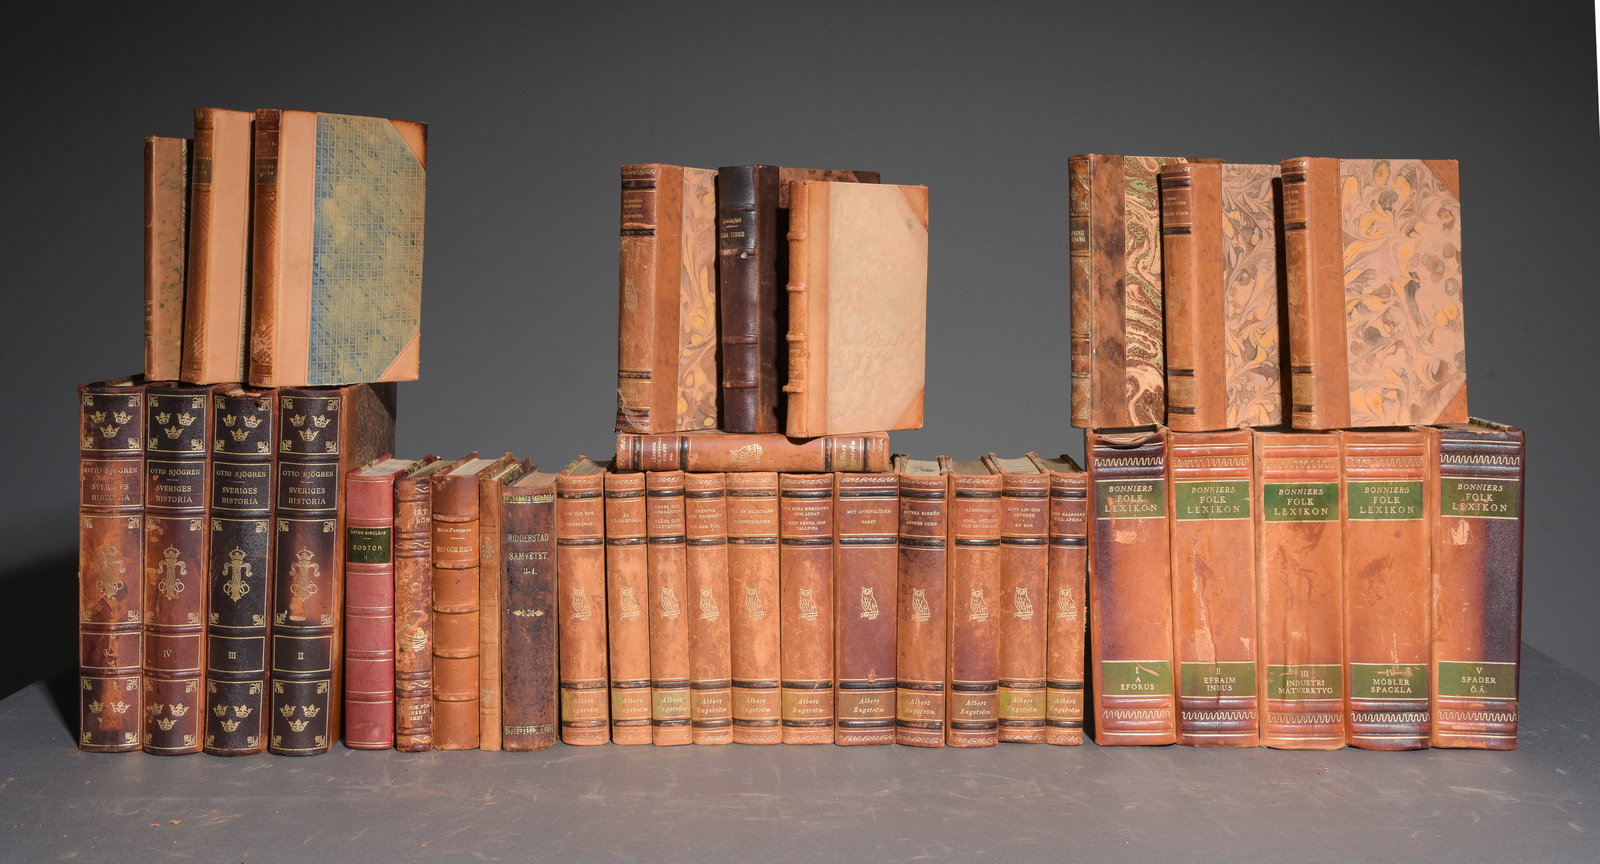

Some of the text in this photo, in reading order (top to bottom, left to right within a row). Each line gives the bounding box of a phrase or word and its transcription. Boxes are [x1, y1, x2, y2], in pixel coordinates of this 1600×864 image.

[168, 467, 201, 477] SJÖGREN
[234, 469, 267, 479] SJÖGREN
[302, 469, 334, 479] SJÖGREN
[155, 484, 192, 493] SVERIGES
[221, 486, 258, 495] SVERIGES
[288, 486, 326, 495] SVERIGES
[1108, 484, 1154, 493] BONNIERS
[1191, 486, 1236, 494] BONNIERS
[1363, 486, 1410, 494] BONNIERS
[1457, 483, 1504, 492] BONNIERS
[1278, 488, 1324, 496] BONNIERS
[91, 494, 131, 502] HISTOIA
[155, 494, 193, 504] HISTORIA
[221, 497, 259, 505] HISTORIA
[287, 497, 327, 505] HISTORIA
[1116, 494, 1144, 503] FOLK
[1199, 496, 1227, 504] FOLK
[1286, 497, 1315, 506] FOLK
[1373, 496, 1401, 504] FOLK
[1465, 493, 1493, 502] FOLK
[1104, 504, 1158, 513] LEXIKON
[1186, 505, 1241, 514] LEXIKON
[1359, 505, 1415, 514] LEXIKON
[1452, 502, 1508, 512] LEXIKON
[1273, 507, 1329, 516] LEXIKON
[508, 533, 549, 543] RIDDERSTAD
[352, 544, 383, 552] BOSTON
[162, 649, 173, 658] IV
[228, 651, 237, 660] III
[297, 652, 305, 660] II
[1216, 667, 1222, 675] II
[1300, 670, 1309, 678] III
[1475, 666, 1483, 675] V
[1203, 676, 1236, 684] EFRAIM
[1372, 677, 1410, 686] MÖBLER
[1461, 676, 1497, 684] SPADER
[1120, 683, 1155, 691] EFORUS
[1206, 684, 1233, 692] INDUS
[1278, 686, 1333, 694] MÄTVERKTYG
[1370, 686, 1413, 694] SPACKLA
[660, 696, 683, 704] Albert
[700, 697, 723, 705] Albert
[797, 697, 820, 705] Albert
[858, 697, 880, 705] Albert
[909, 698, 931, 706] Albert
[964, 699, 987, 707] Albert
[1011, 696, 1033, 704] Albert
[1054, 697, 1076, 705] Albert
[792, 706, 824, 715] Engström
[852, 706, 885, 715] Engström
[959, 707, 991, 717] Engström
